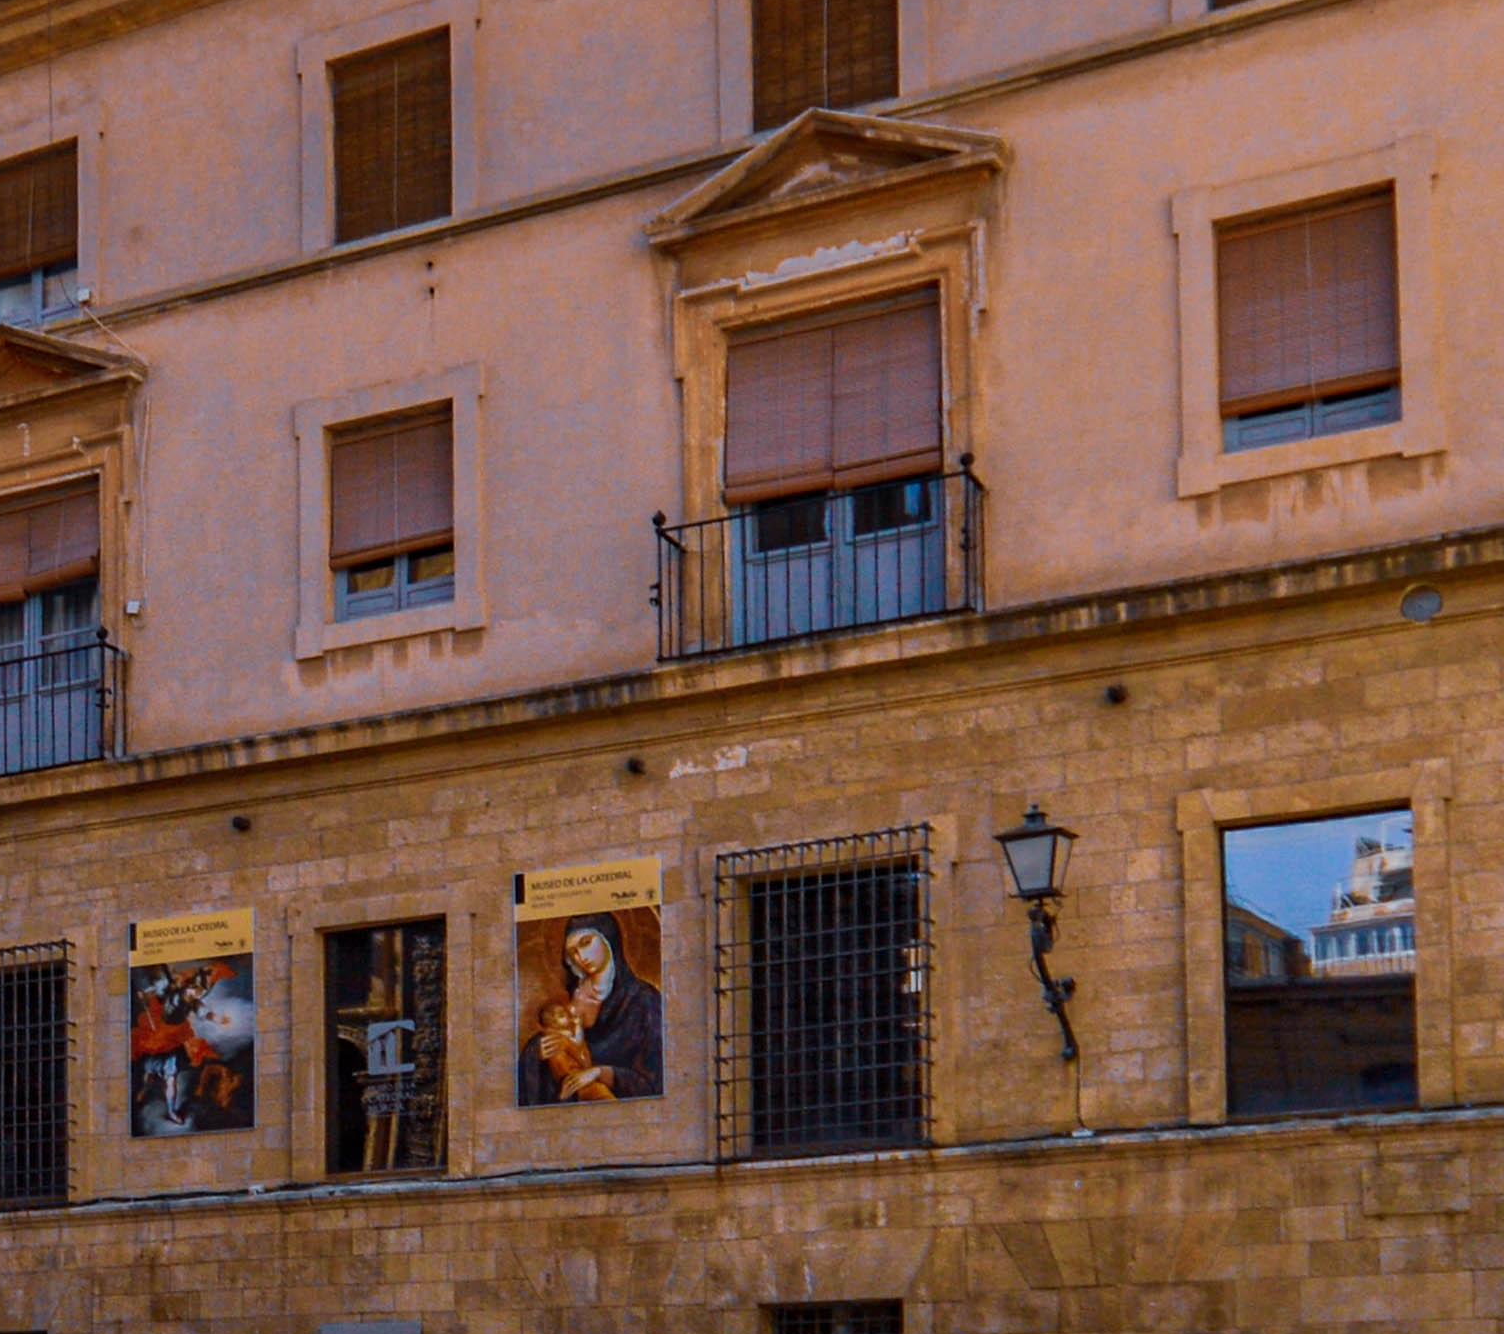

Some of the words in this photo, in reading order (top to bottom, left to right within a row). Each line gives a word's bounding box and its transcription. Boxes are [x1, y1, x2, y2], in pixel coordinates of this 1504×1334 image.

[531, 879, 561, 890] MUSEO
[563, 877, 574, 887] DE
[577, 875, 588, 885] LA
[589, 870, 632, 884] CATEDRAL
